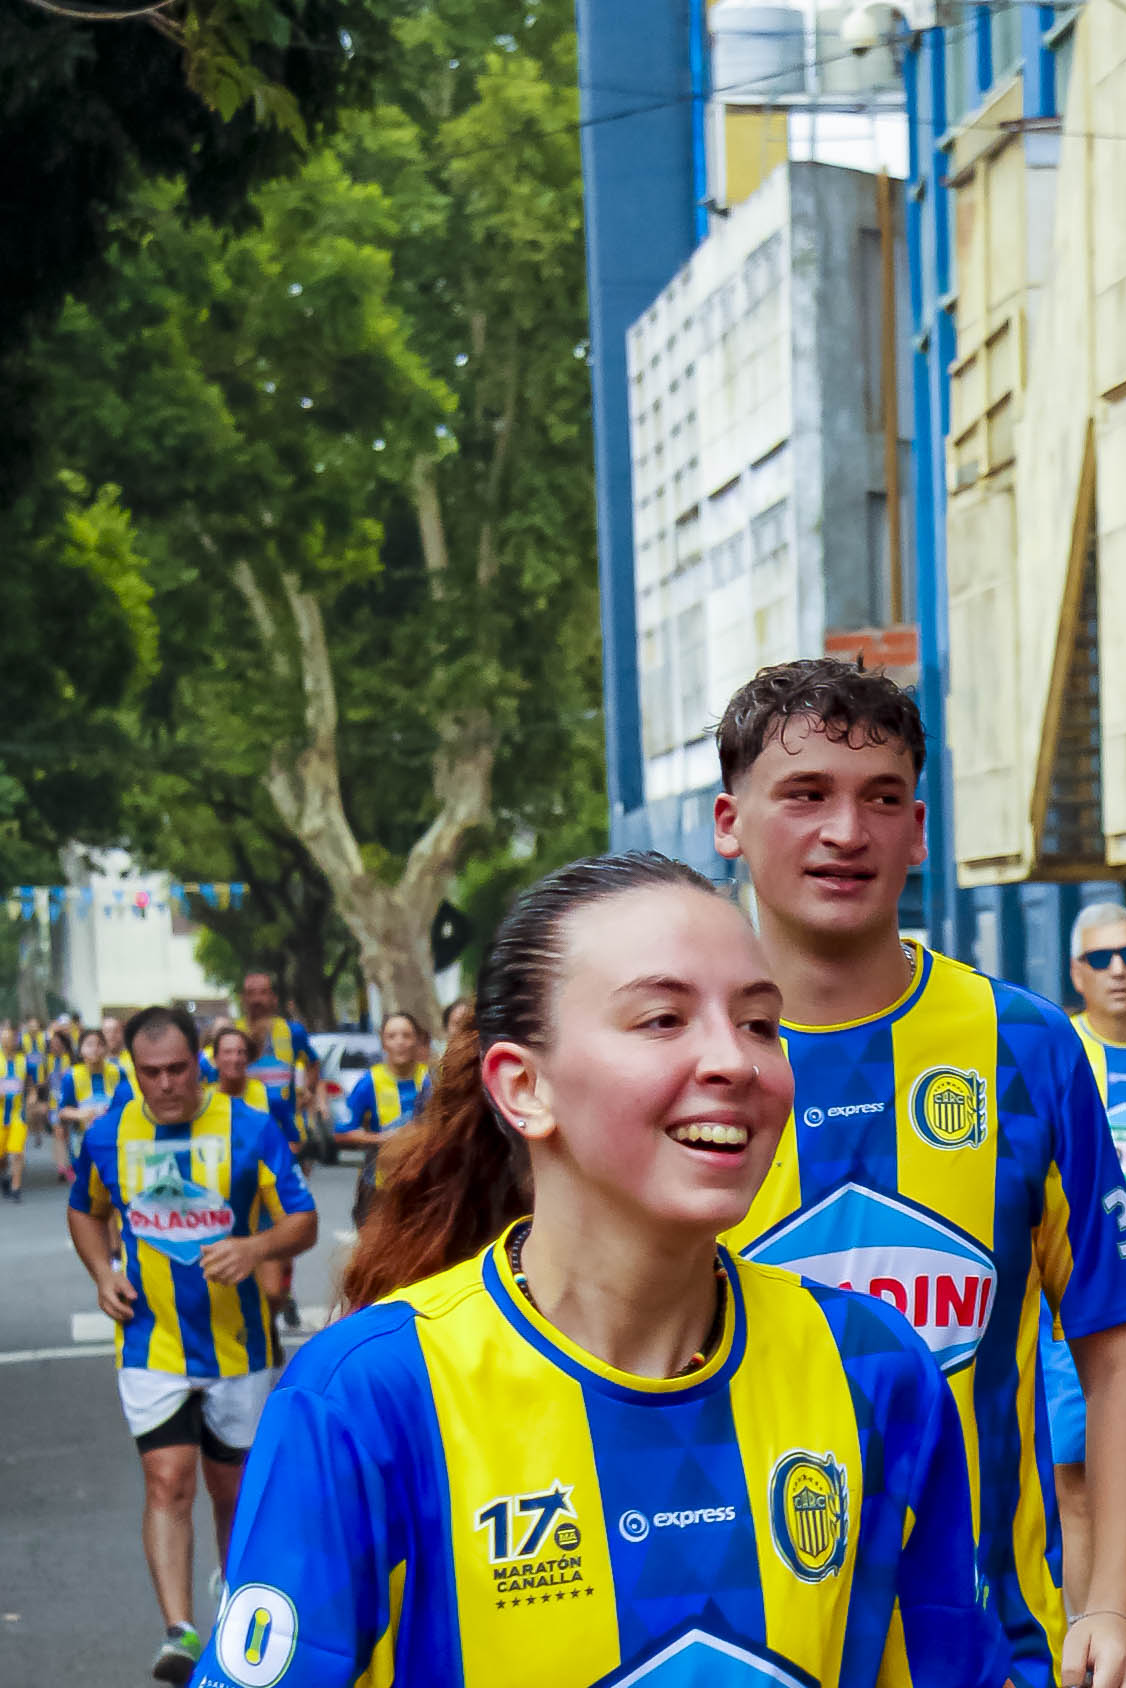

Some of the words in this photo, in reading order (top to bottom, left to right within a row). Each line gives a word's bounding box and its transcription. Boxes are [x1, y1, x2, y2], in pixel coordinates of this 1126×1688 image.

[827, 1102, 885, 1117] express
[474, 1480, 577, 1564] 17
[653, 1505, 736, 1528] express
[493, 1555, 582, 1580] MARATÓN
[497, 1570, 583, 1592] CANALLA
